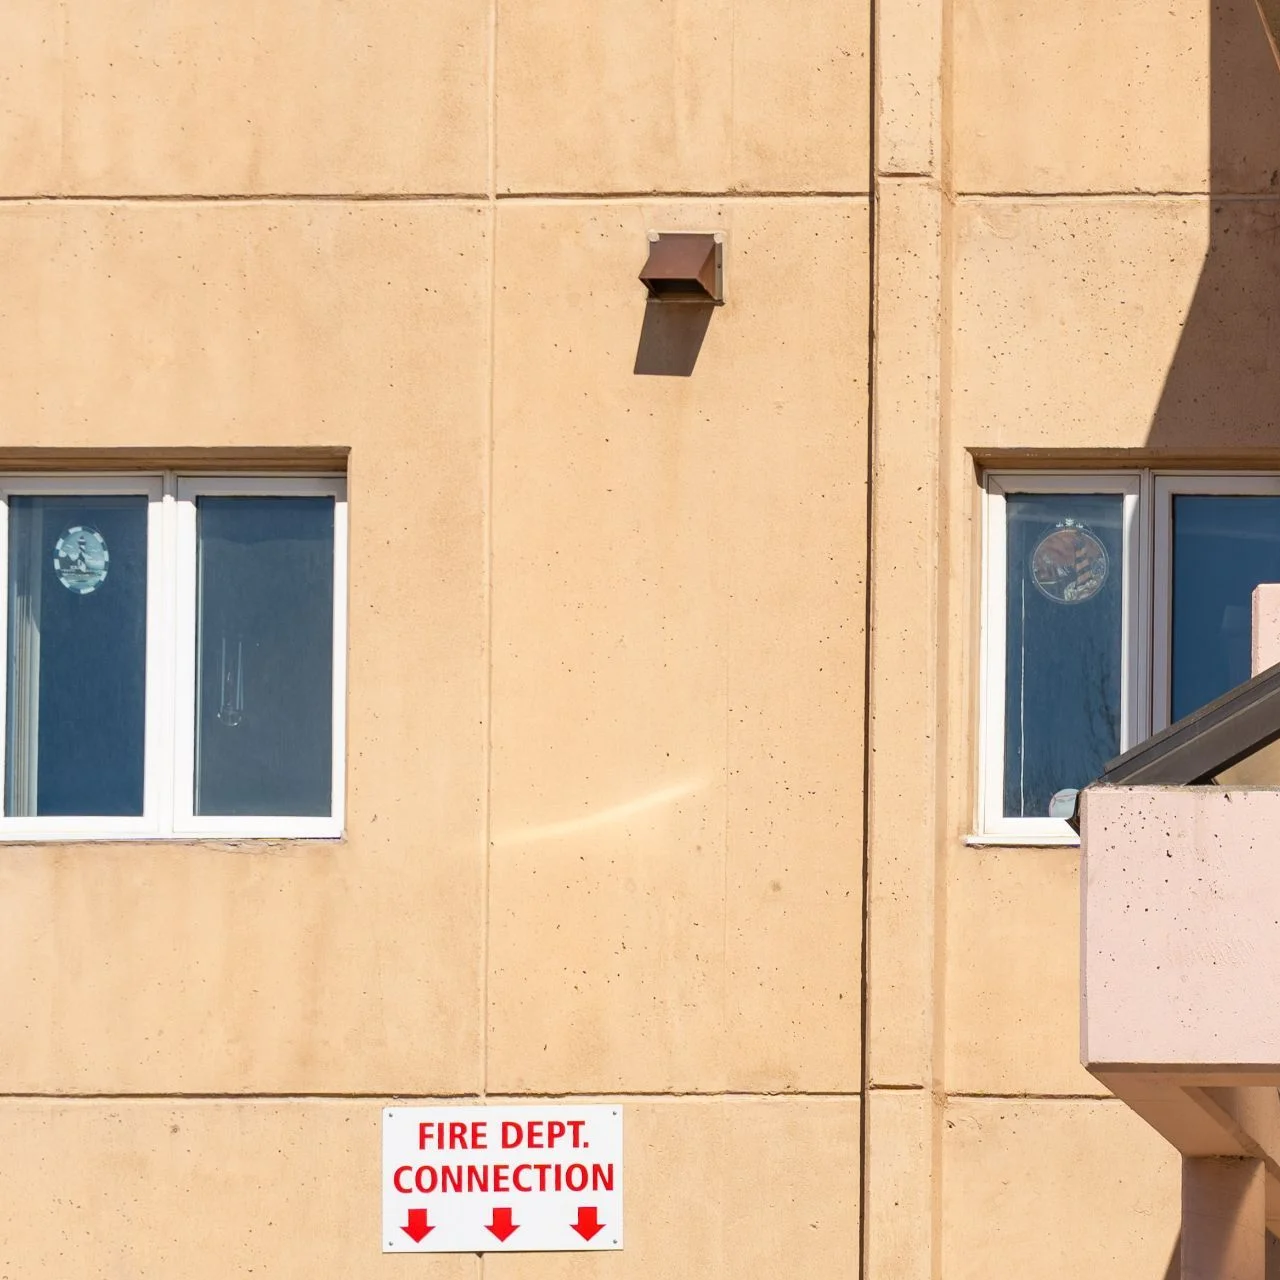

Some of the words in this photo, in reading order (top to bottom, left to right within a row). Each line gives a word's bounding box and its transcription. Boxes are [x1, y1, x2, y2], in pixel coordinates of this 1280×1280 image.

[418, 1121, 488, 1150] FIRE
[501, 1120, 589, 1149] DEPT.
[393, 1163, 614, 1194] CONNECTION
